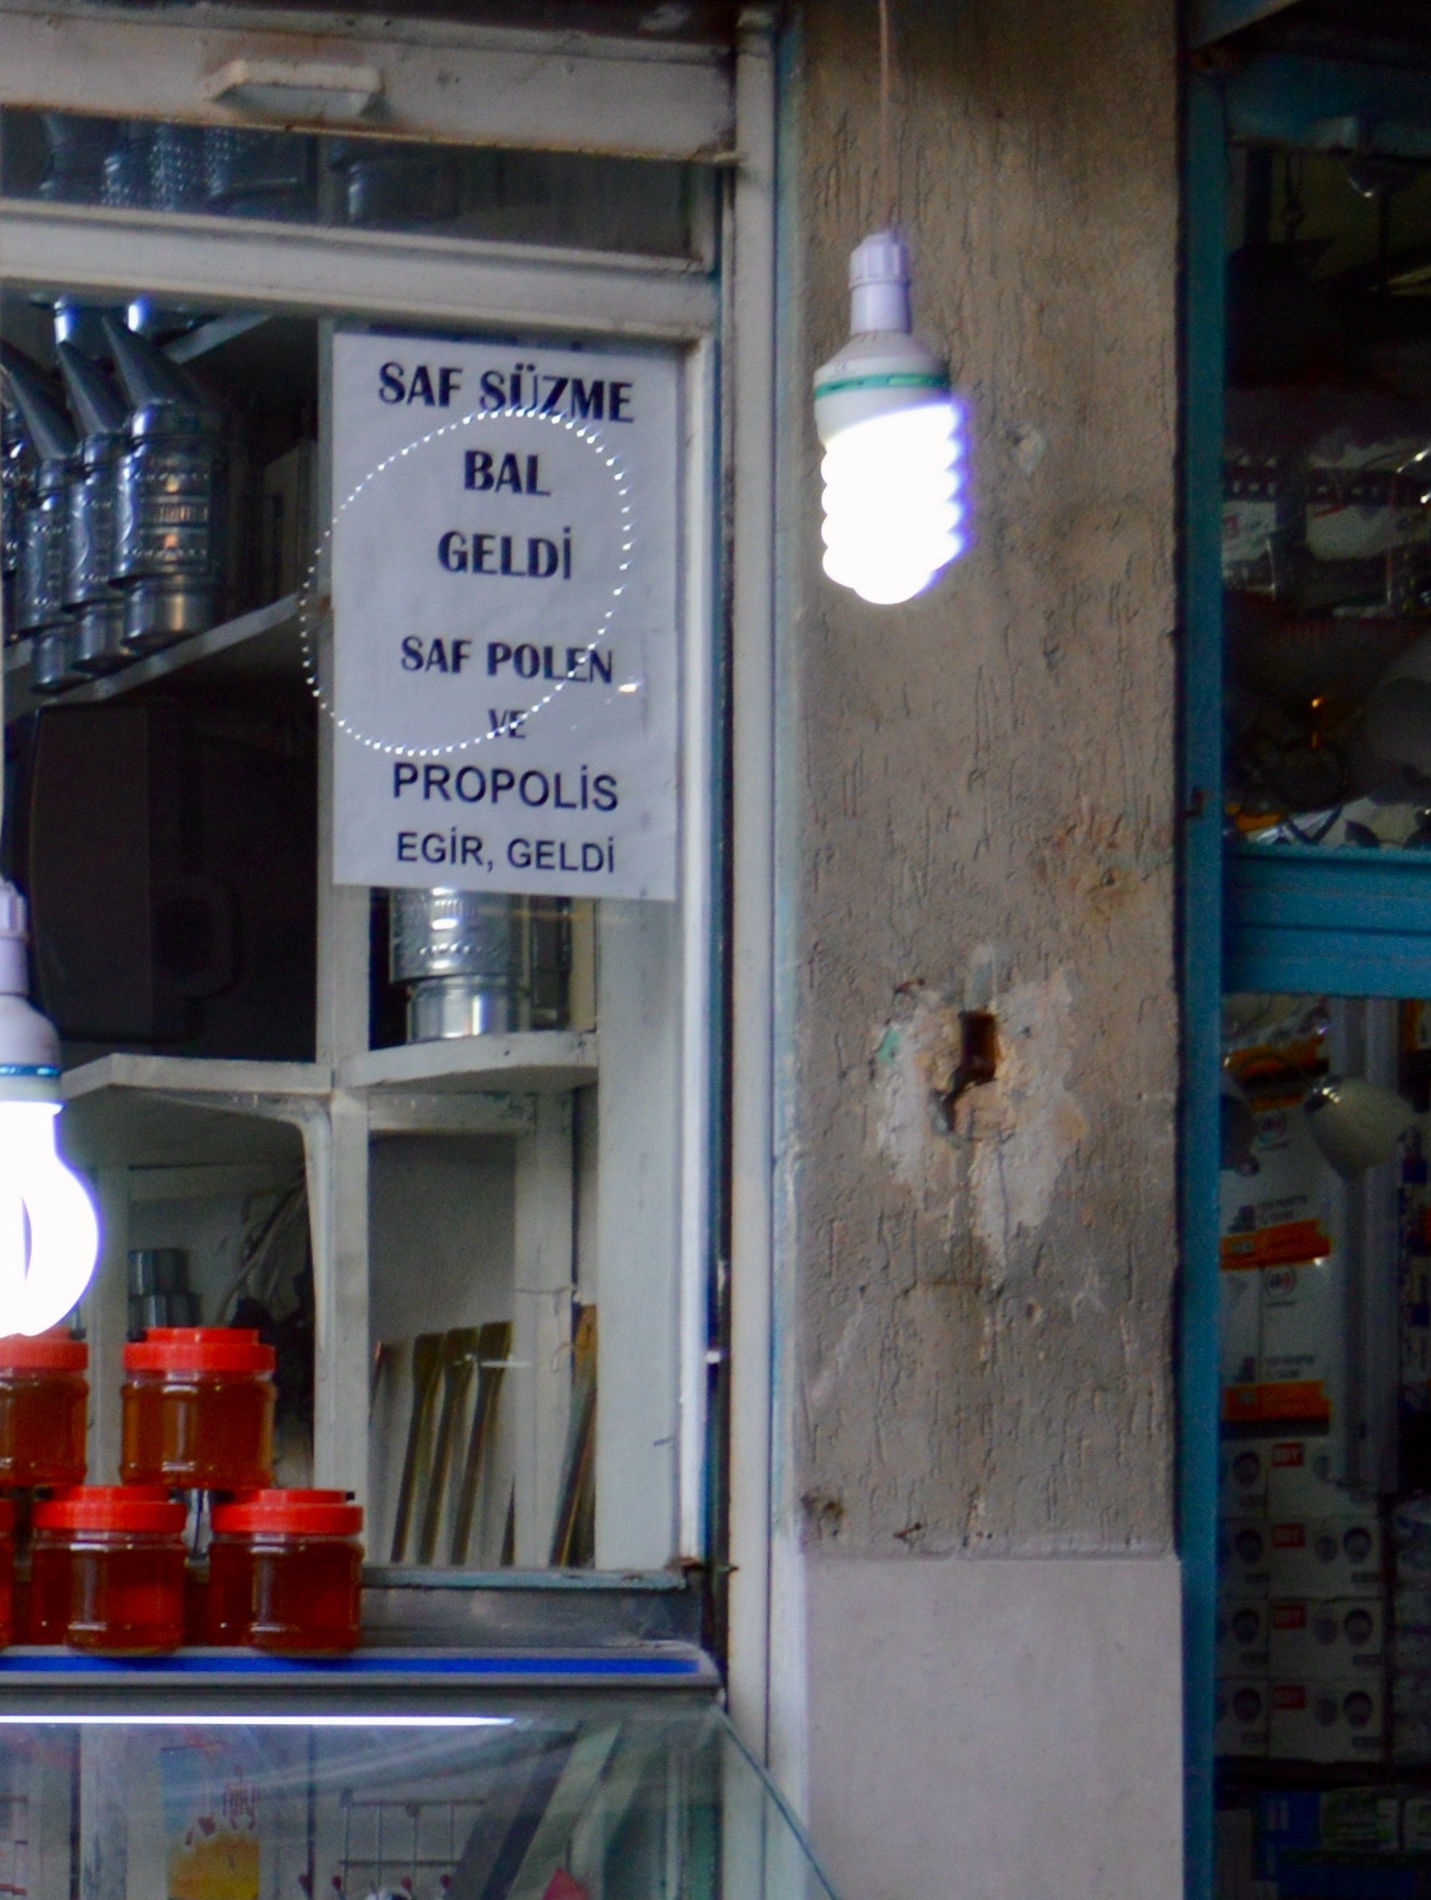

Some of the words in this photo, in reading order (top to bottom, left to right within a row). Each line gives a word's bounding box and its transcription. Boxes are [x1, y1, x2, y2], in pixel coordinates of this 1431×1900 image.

[378, 361, 463, 407] SAF
[479, 365, 634, 423] SÜZME
[463, 450, 551, 496] BAL
[438, 526, 572, 580] GELDİ
[401, 636, 472, 675] SAF
[487, 642, 613, 683] POLEN
[488, 709, 527, 739] VE
[393, 762, 619, 811] PROPOLİS
[507, 836, 614, 872] GELDİ
